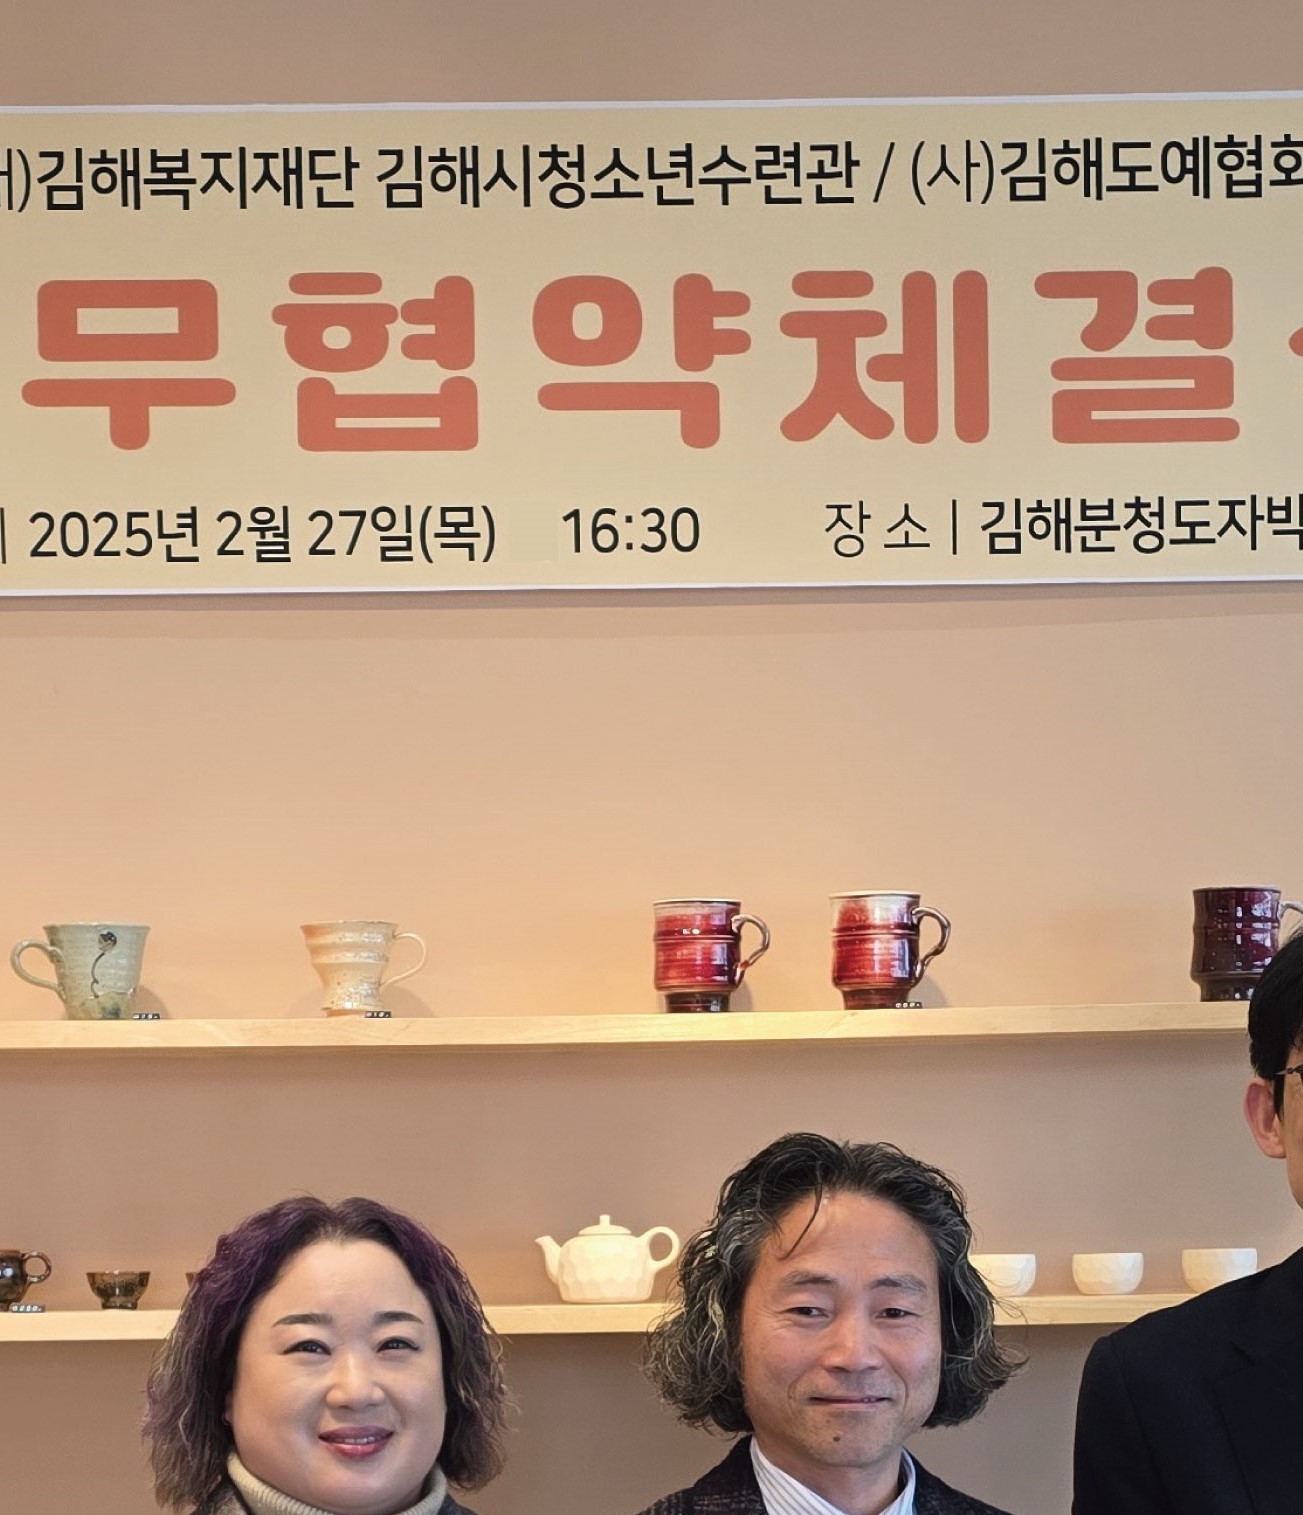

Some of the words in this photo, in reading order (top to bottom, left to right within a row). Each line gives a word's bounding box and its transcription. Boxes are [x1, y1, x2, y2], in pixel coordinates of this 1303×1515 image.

[376, 140, 861, 210] 김해시청소년수련관
[28, 505, 200, 564] 2025년
[216, 505, 292, 563] 2월
[308, 504, 496, 565] 27일(목)
[561, 506, 700, 554] 16:30
